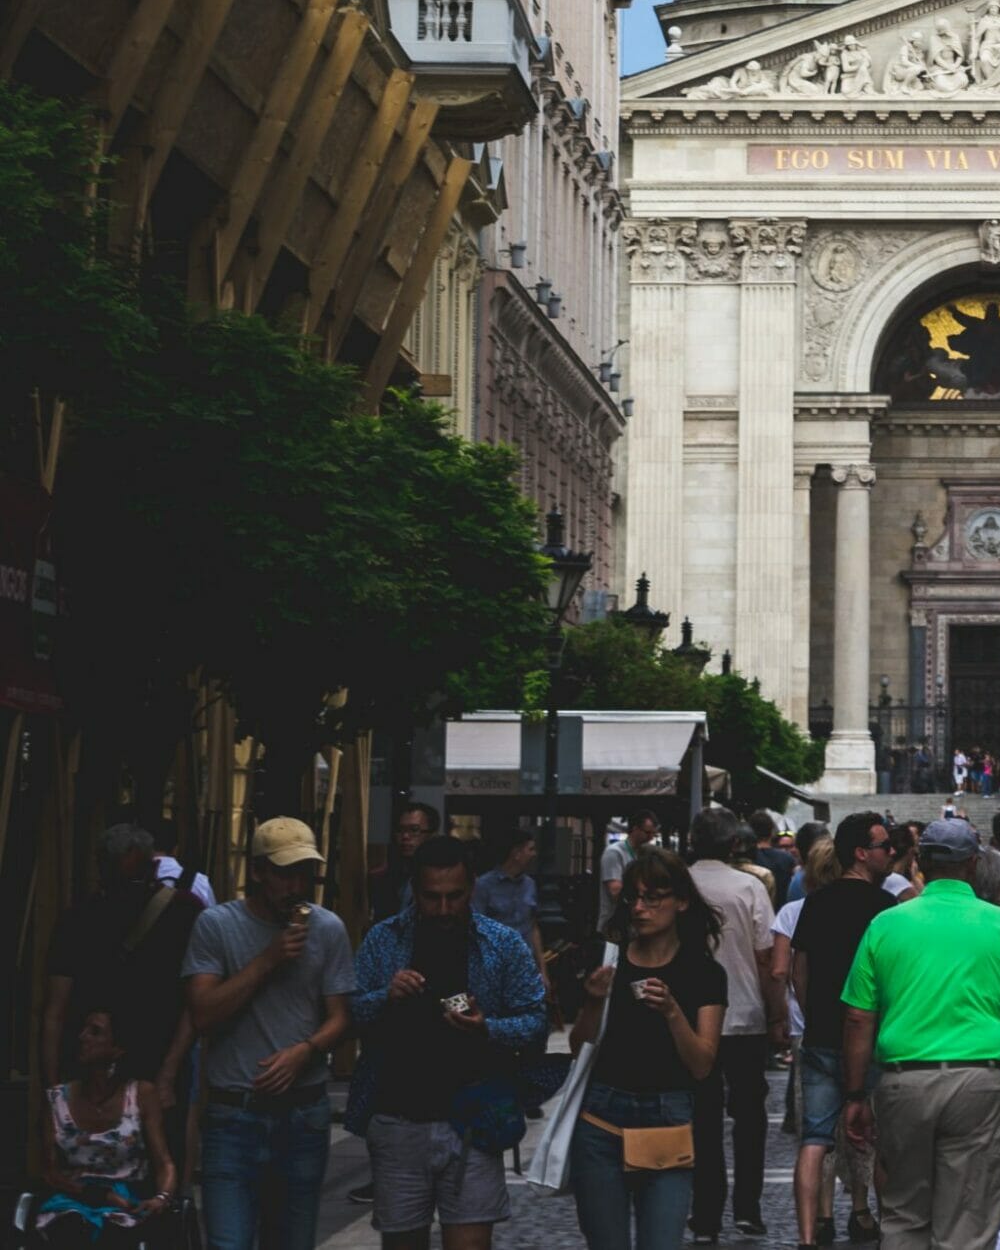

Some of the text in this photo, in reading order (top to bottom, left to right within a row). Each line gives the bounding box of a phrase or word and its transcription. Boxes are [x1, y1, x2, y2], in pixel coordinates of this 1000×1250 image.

[775, 149, 830, 170] EGO
[847, 149, 905, 170] SUM
[925, 149, 969, 170] VIA
[470, 776, 512, 790] Coffee
